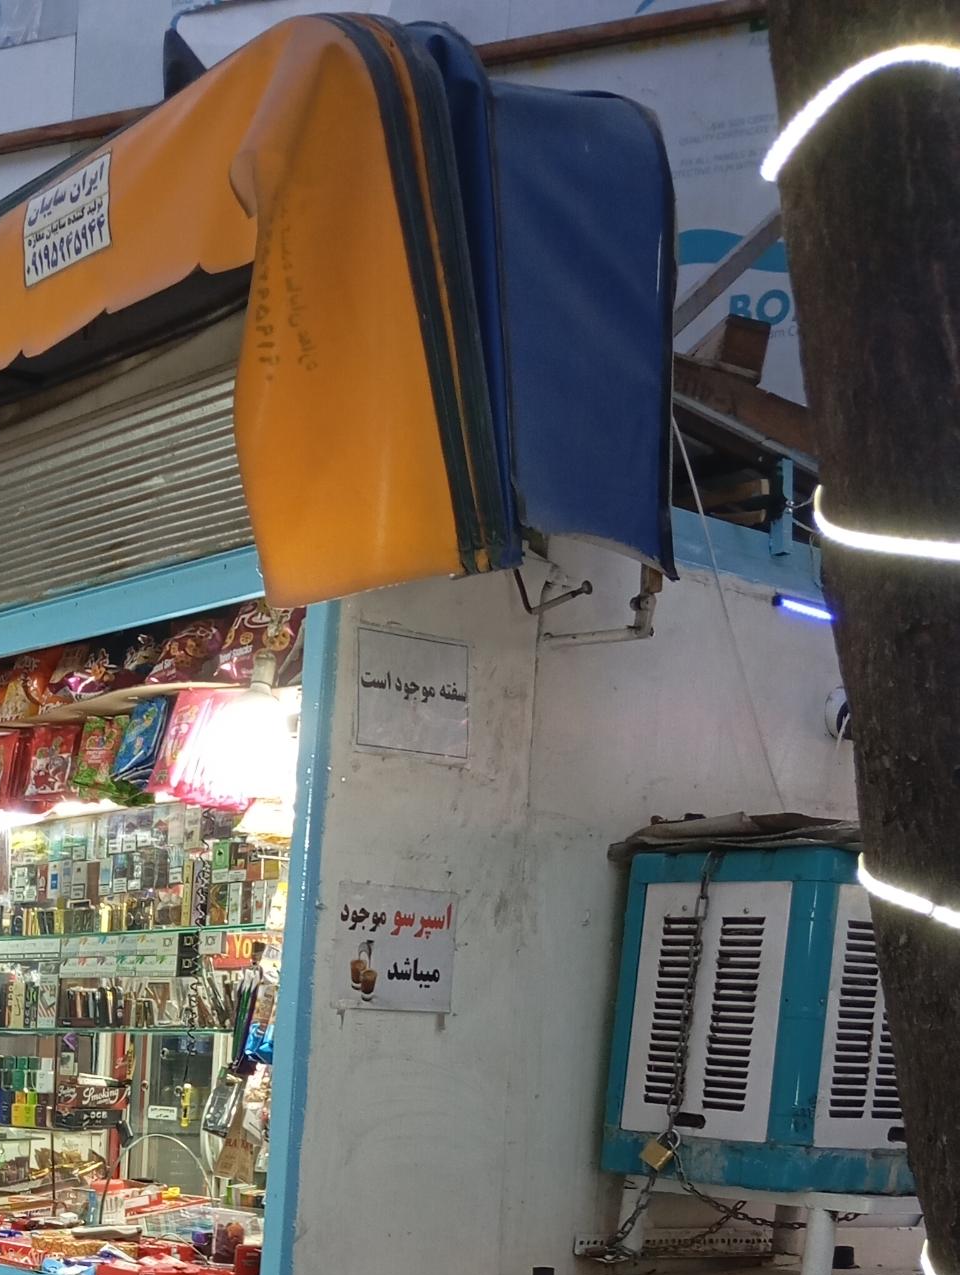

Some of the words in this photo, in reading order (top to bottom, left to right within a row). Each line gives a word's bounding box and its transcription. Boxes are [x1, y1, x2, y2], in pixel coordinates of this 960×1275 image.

[70, 161, 105, 203] ایران
[28, 187, 66, 227] سایبان
[26, 213, 106, 277] ۰۹۱۹۵۹۴۵۹۴۴
[361, 671, 391, 690] است
[395, 677, 435, 703] موجود
[341, 904, 386, 932] موجود
[390, 902, 452, 939] اسپرسو
[387, 957, 440, 988] میباشد
[82, 1087, 119, 1105] Smoking
